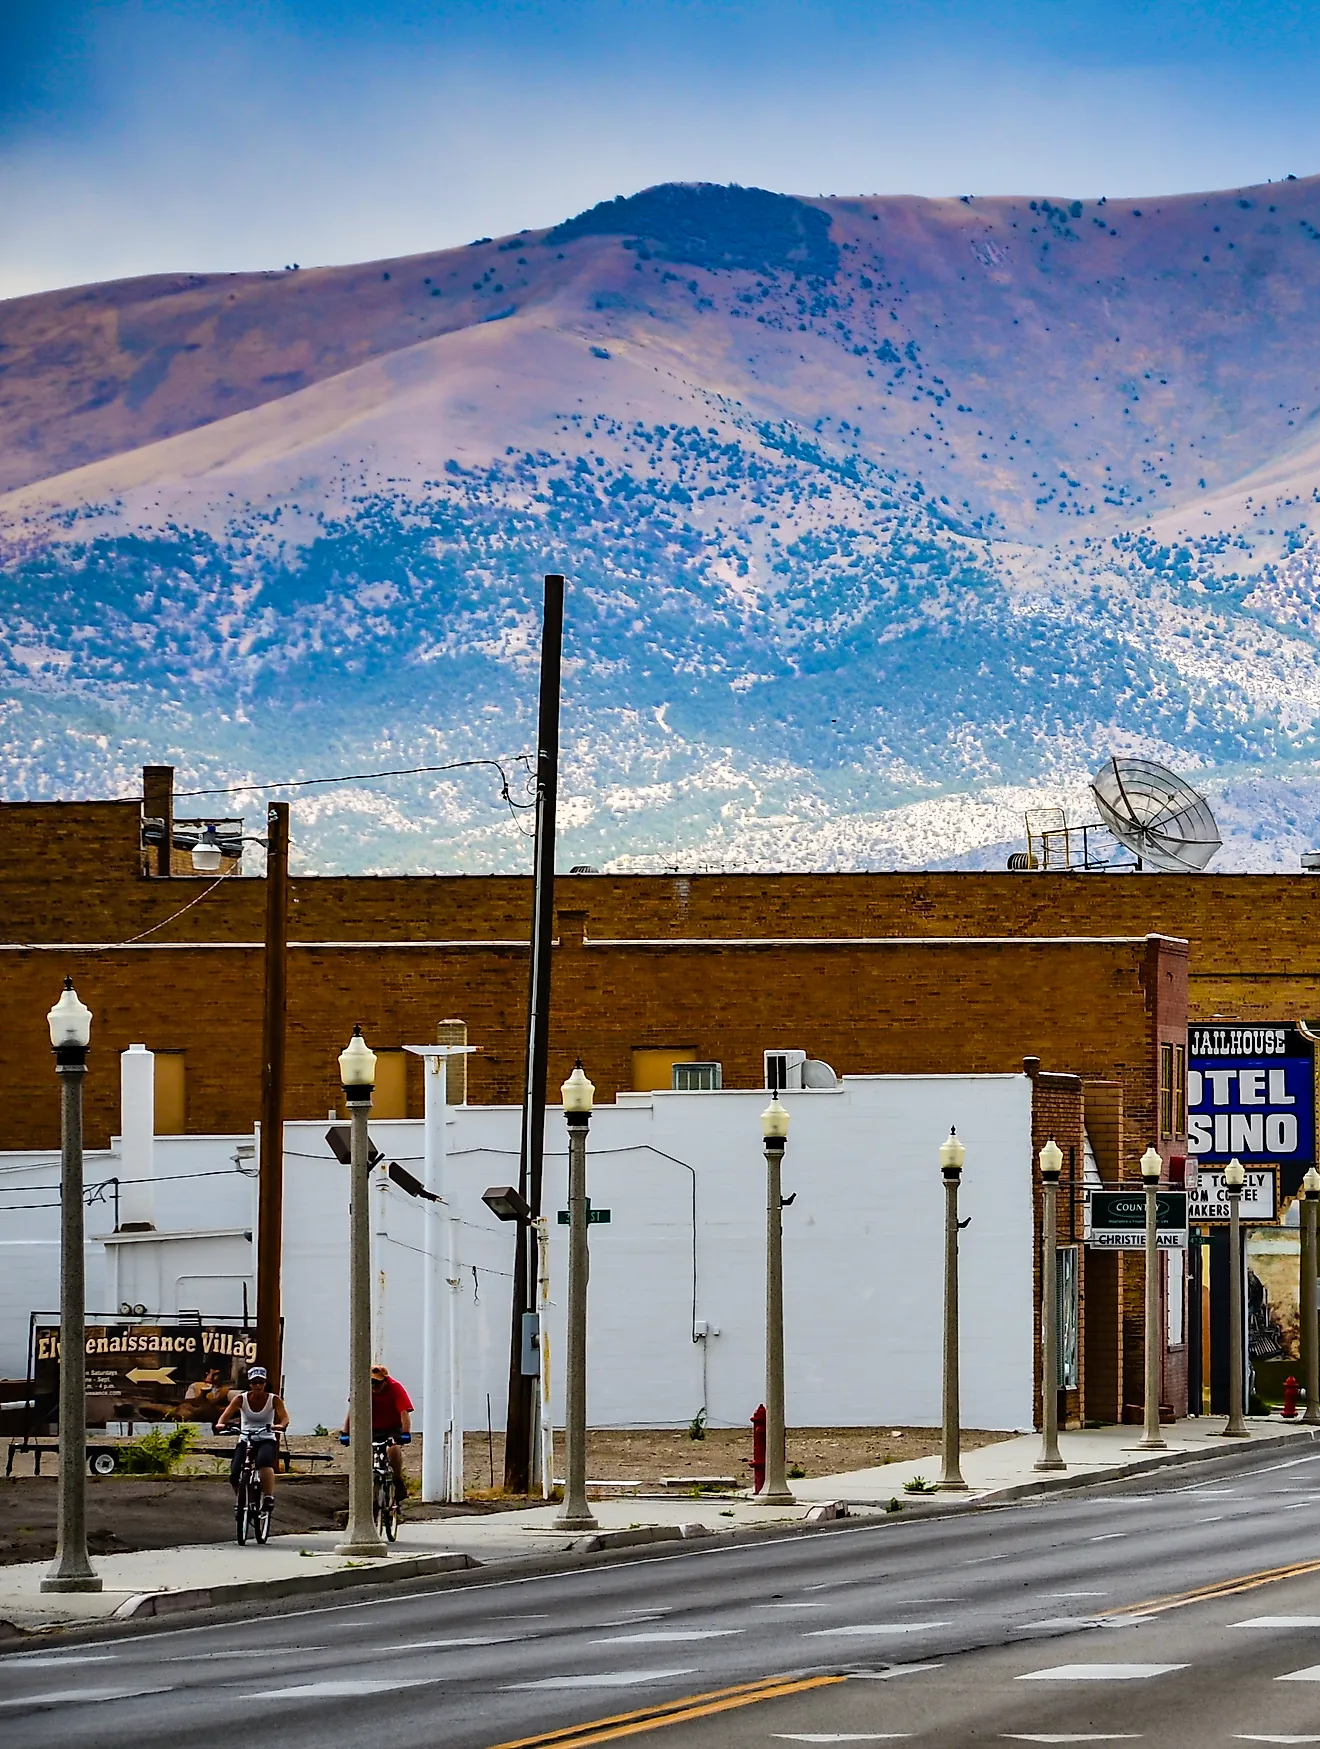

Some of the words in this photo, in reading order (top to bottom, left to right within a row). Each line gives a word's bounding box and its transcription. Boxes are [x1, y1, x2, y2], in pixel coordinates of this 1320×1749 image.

[1191, 1030, 1286, 1055] JAILHOUSE
[1188, 1114, 1298, 1153] SINO
[1116, 1203, 1160, 1212] COUNTY
[591, 1212, 601, 1221] ST
[1099, 1235, 1146, 1245] CHRISTIE
[1156, 1235, 1178, 1245] ANE
[86, 1331, 196, 1354] enaissance
[201, 1332, 257, 1363] Villag
